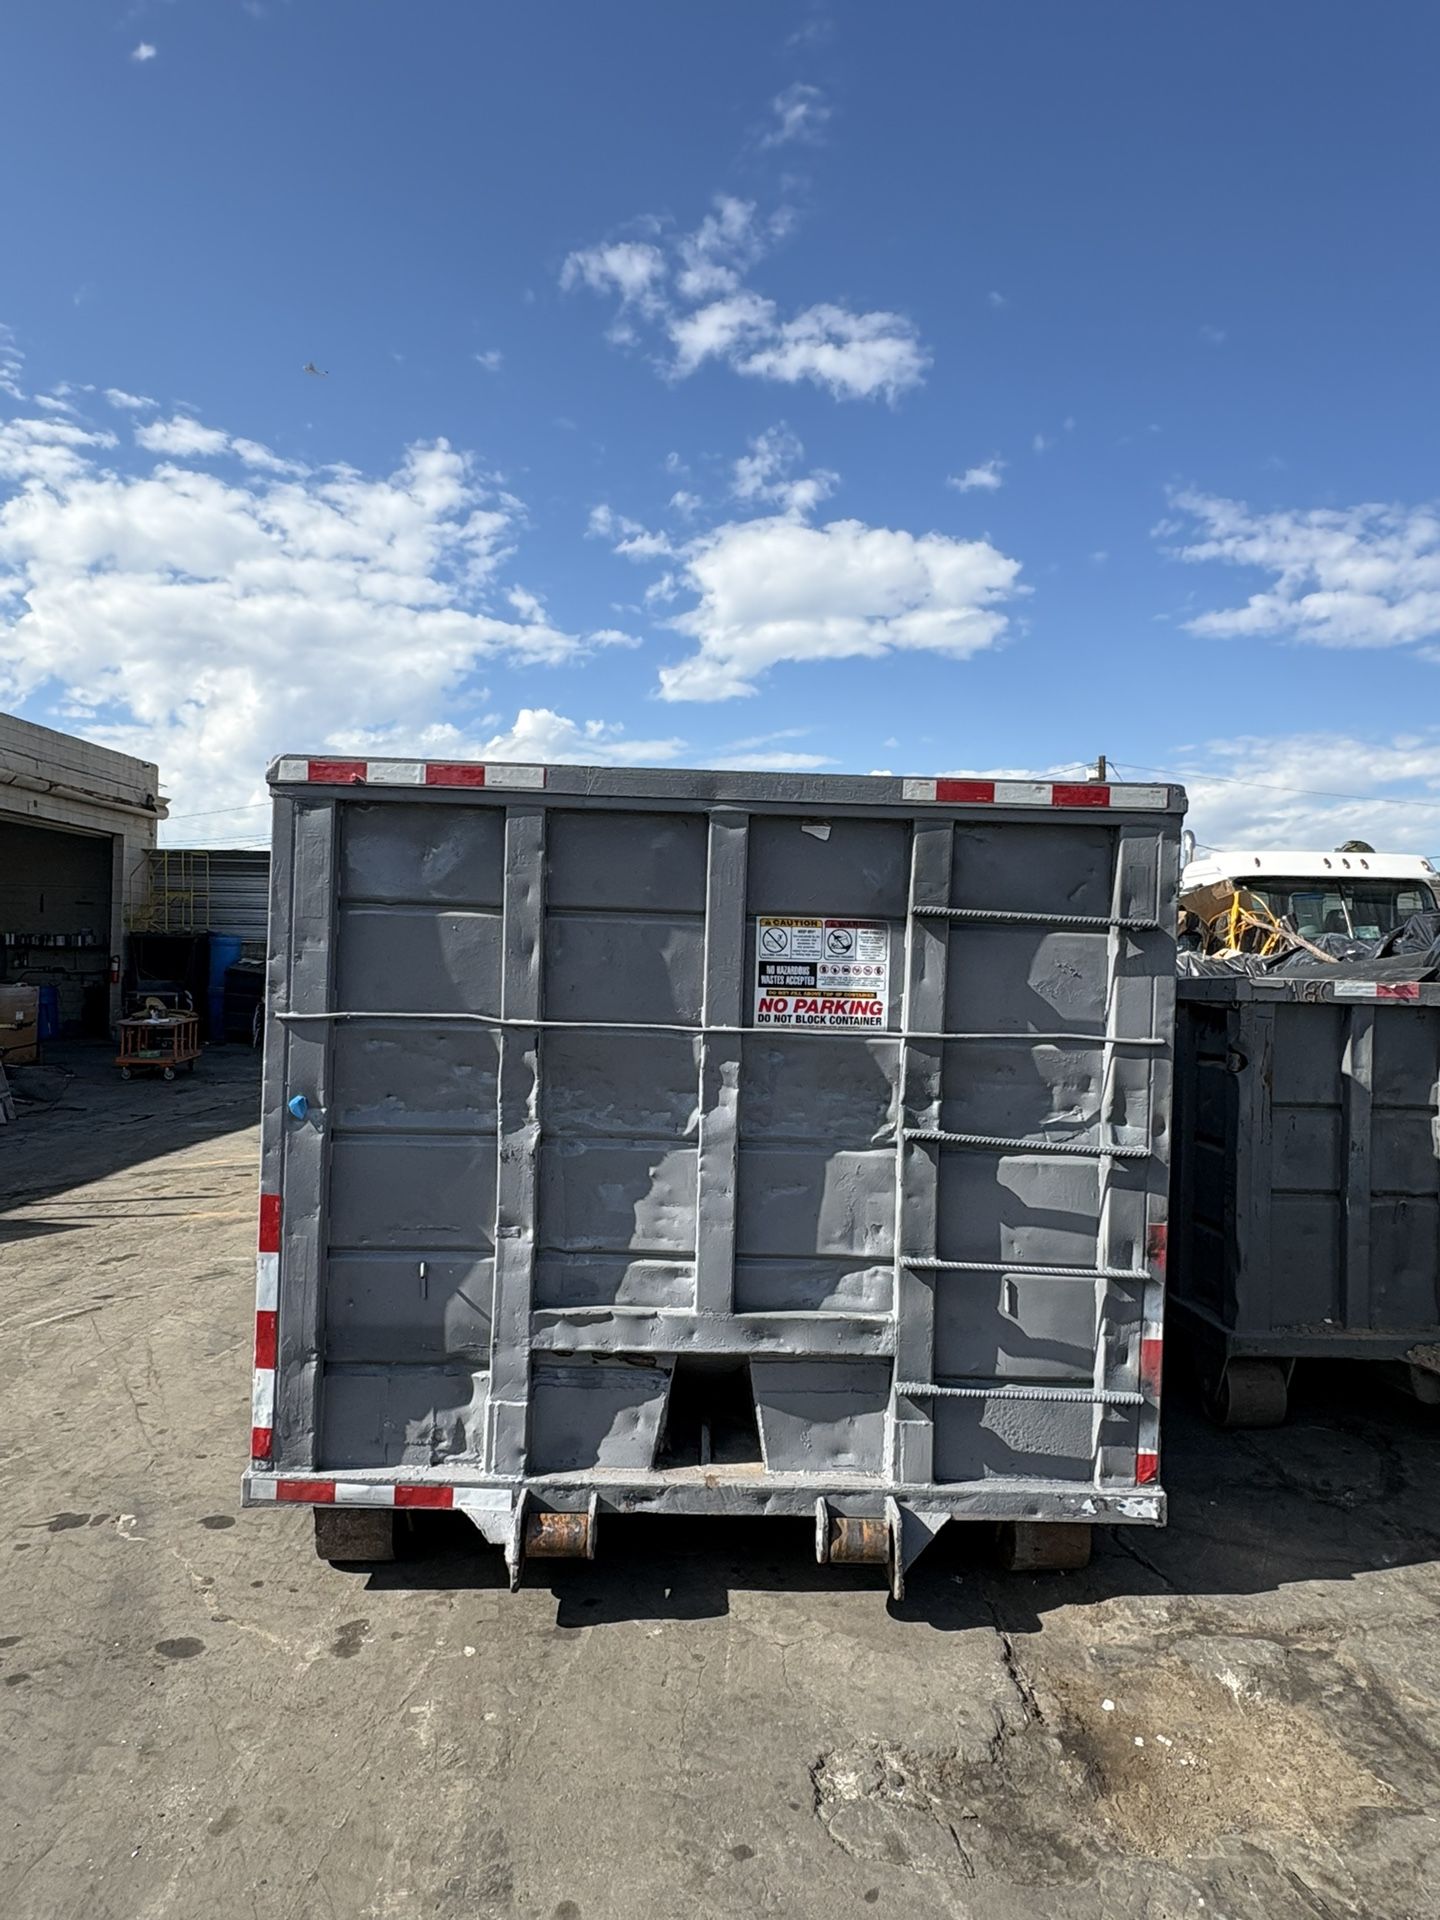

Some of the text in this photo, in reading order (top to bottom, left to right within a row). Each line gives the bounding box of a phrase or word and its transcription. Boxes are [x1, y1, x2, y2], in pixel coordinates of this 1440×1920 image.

[773, 919, 818, 927] CAUTION
[766, 965, 809, 975] NO HAZARDOUS
[761, 975, 784, 985] WASTES
[785, 975, 815, 986] ACCEPTED
[758, 997, 884, 1016] NO PARKING
[757, 1014, 882, 1026] DO NOT BLOCK CONTAINER
